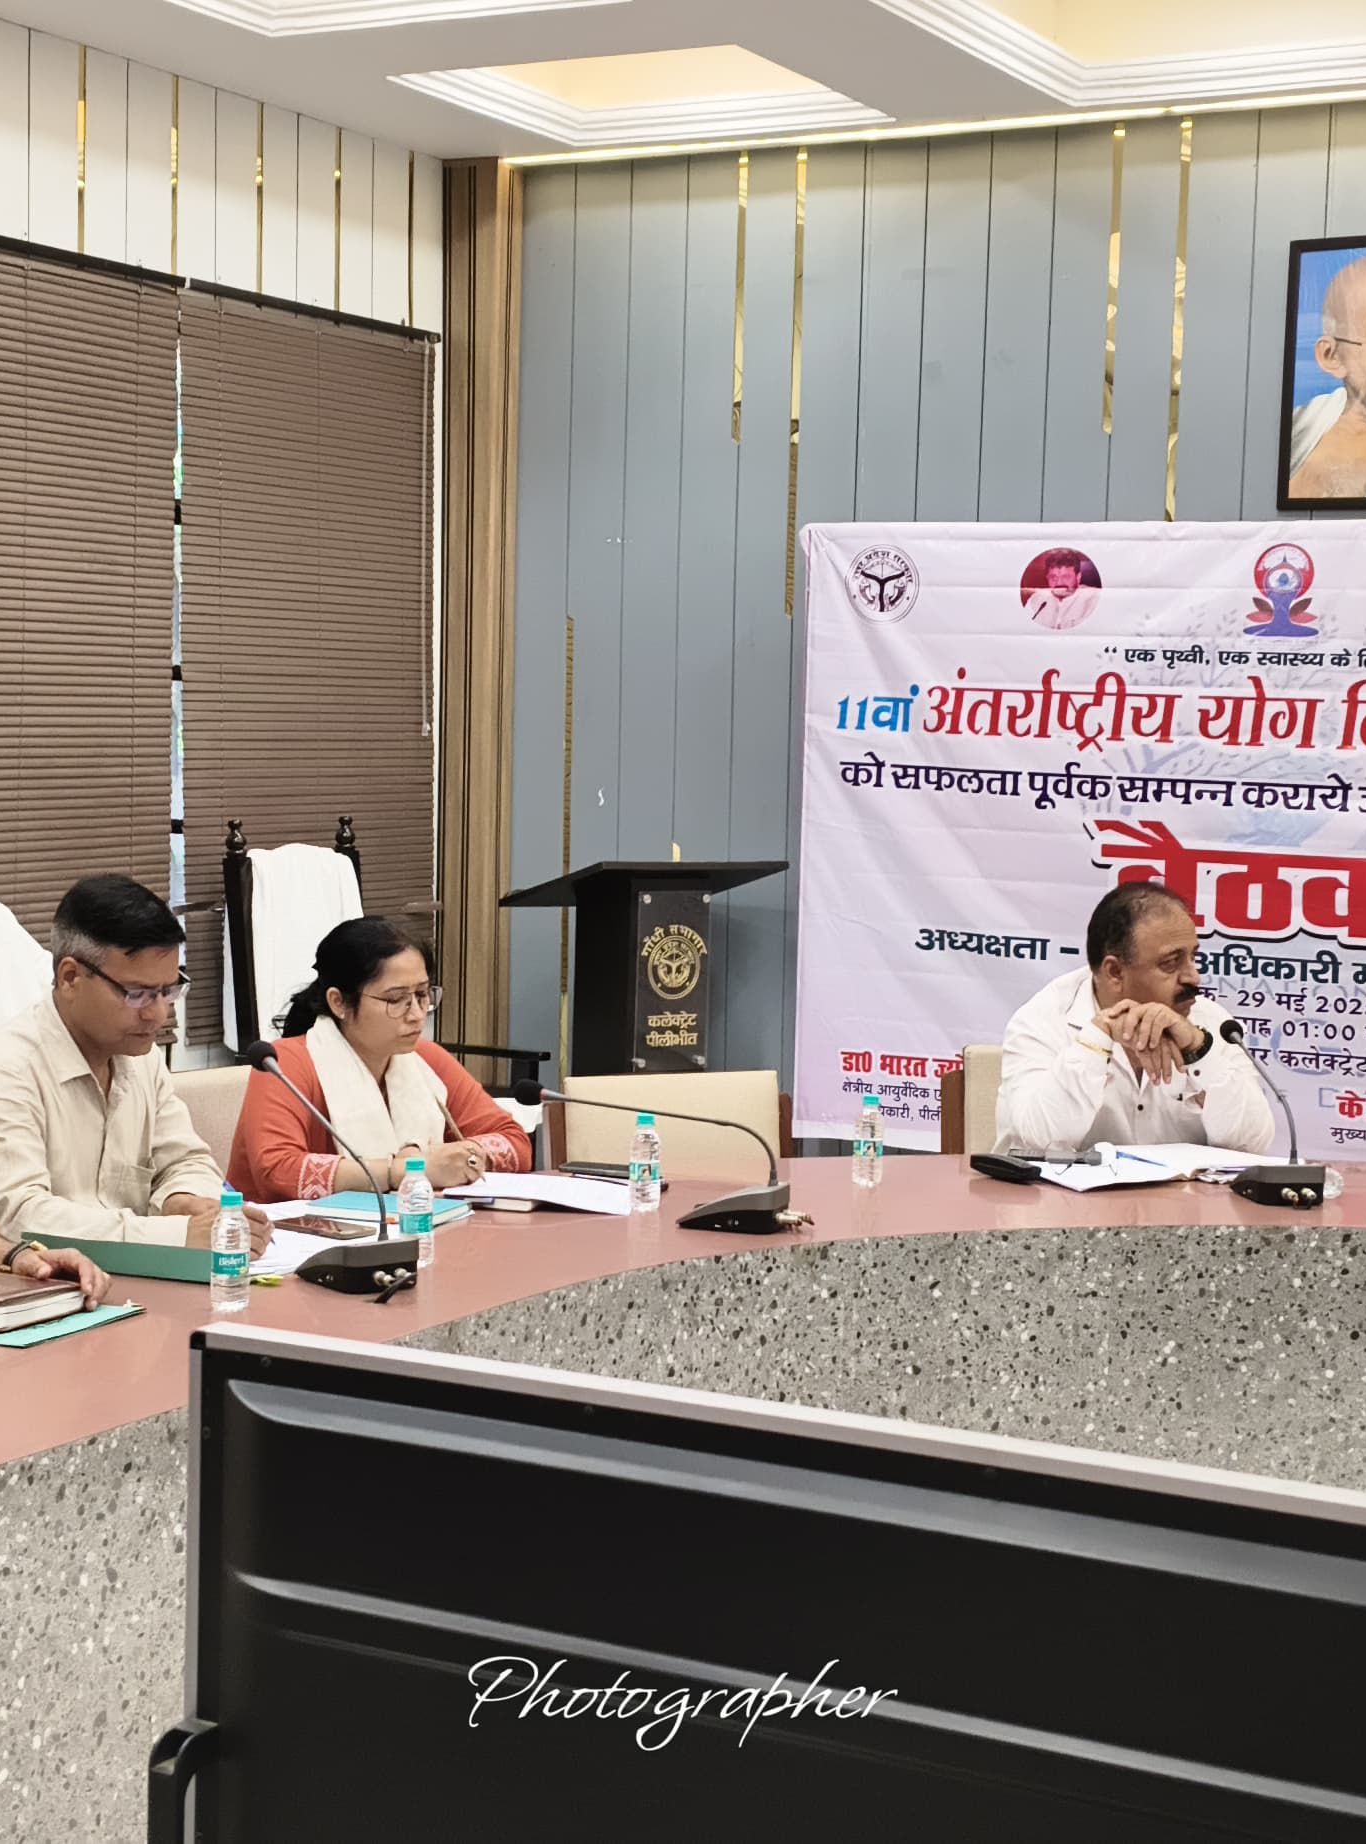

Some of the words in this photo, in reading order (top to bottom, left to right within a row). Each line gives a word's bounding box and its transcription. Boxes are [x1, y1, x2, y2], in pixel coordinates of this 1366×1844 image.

[1125, 648, 1156, 664] एक
[1162, 645, 1210, 669] पृथ्वी,
[1218, 650, 1250, 665] एक
[1330, 647, 1351, 668] के
[836, 684, 920, 733] 11वां
[923, 667, 1183, 752] अंतर्राष्ट्रीय
[1198, 676, 1325, 749] योग
[840, 752, 885, 788] को
[891, 763, 1023, 797] सफलता
[1028, 761, 1114, 810] पूर्वक
[1117, 776, 1237, 808] सम्पन्न
[1242, 773, 1352, 812] कराये
[915, 928, 1051, 961] अध्यक्षता
[1237, 989, 1266, 1008] 29
[1275, 987, 1307, 1016] मई
[646, 1029, 699, 1047] पीलीभीत
[1282, 1020, 1356, 1041] 01:00
[880, 1054, 929, 1078] भारत
[842, 1077, 873, 1094] क्षेत्रीय
[877, 1081, 930, 1101] आयुर्वेदिक
[1330, 1127, 1366, 1144] मुख्य
